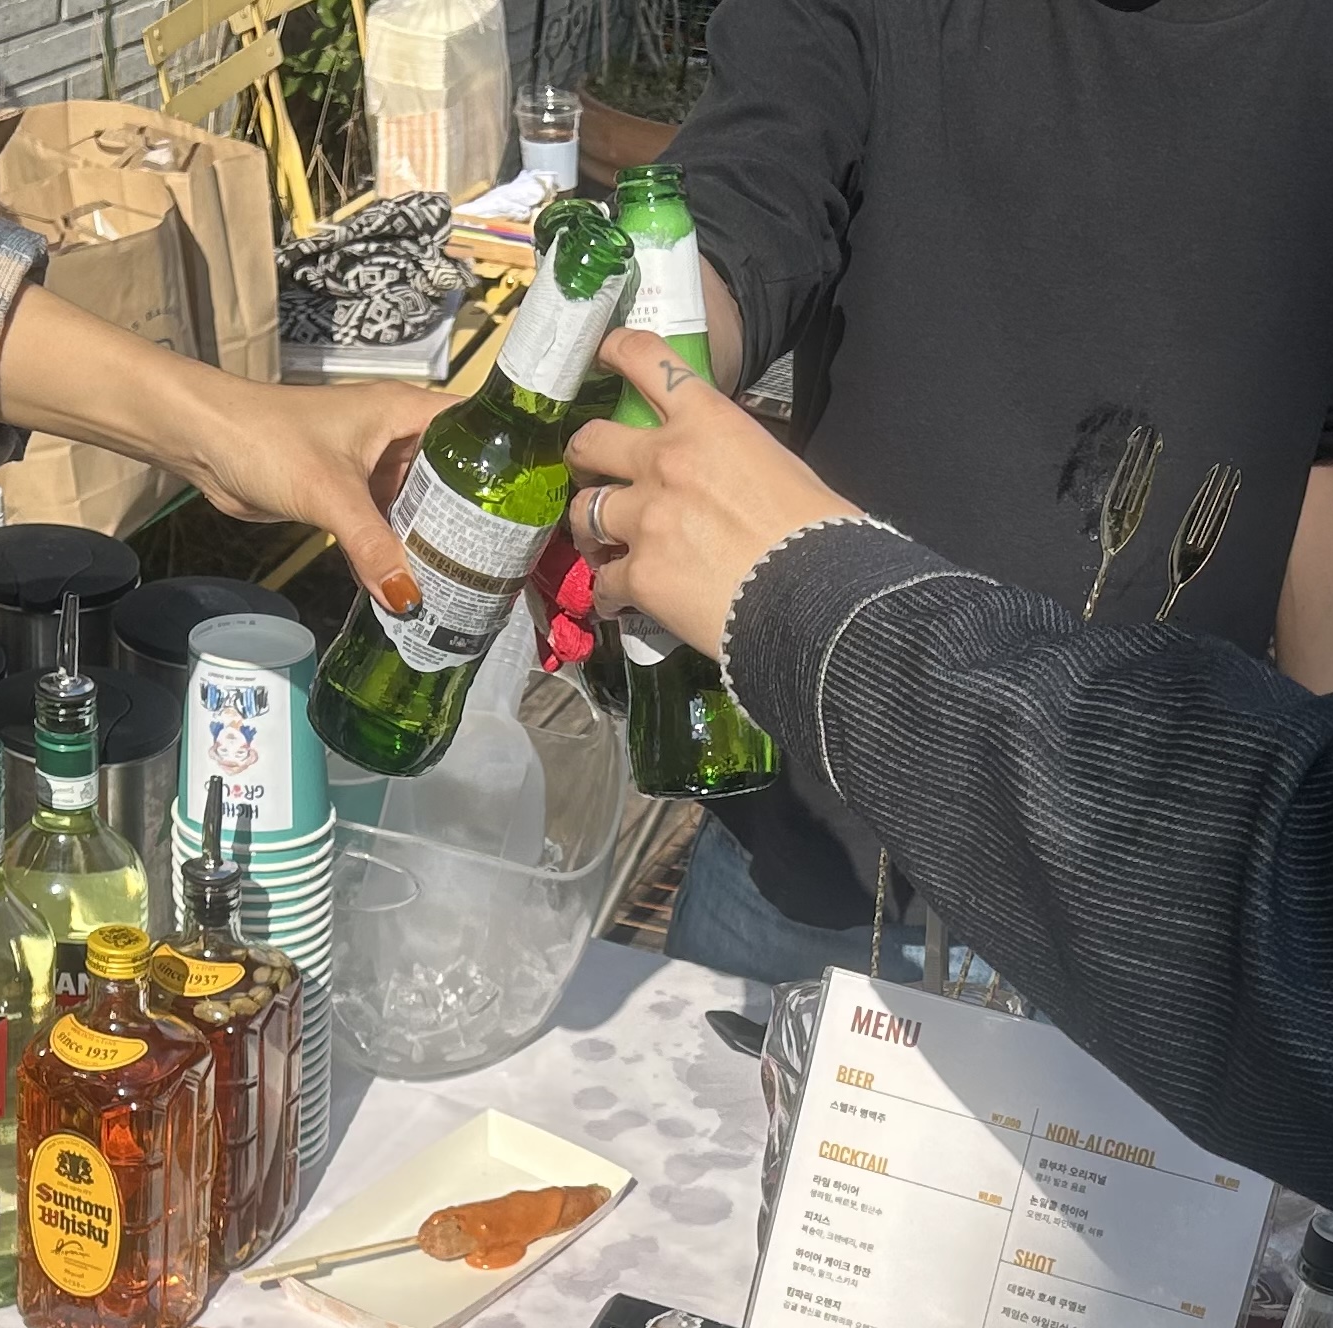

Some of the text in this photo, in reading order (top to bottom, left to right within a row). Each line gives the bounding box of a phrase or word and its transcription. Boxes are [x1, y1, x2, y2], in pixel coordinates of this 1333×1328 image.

[628, 621, 669, 642] Belgiu
[156, 960, 219, 987] since 1937
[850, 1006, 920, 1048] MENU
[56, 1030, 119, 1062] since 1937
[836, 1065, 874, 1089] BEER
[830, 1100, 885, 1122] 스텔라 병맥주
[818, 1140, 888, 1173] COCKTAIL
[1046, 1123, 1158, 1168] NON-ALCOHOL
[1039, 1158, 1106, 1185] 콤부차 오리지널
[812, 1175, 859, 1195] 라임 하이어
[36, 1182, 113, 1226] Suntory
[1060, 1204, 1088, 1219] 하이어
[38, 1202, 110, 1249] Whisky
[804, 1211, 830, 1225] 피치스
[795, 1248, 870, 1277] 하이어 케이크 한잔
[1014, 1249, 1055, 1274] SHOT
[815, 1295, 841, 1310] 오렌지
[1007, 1283, 1034, 1299] 데킬라
[1037, 1292, 1055, 1304] 호세
[1001, 1306, 1028, 1322] 제임슨
